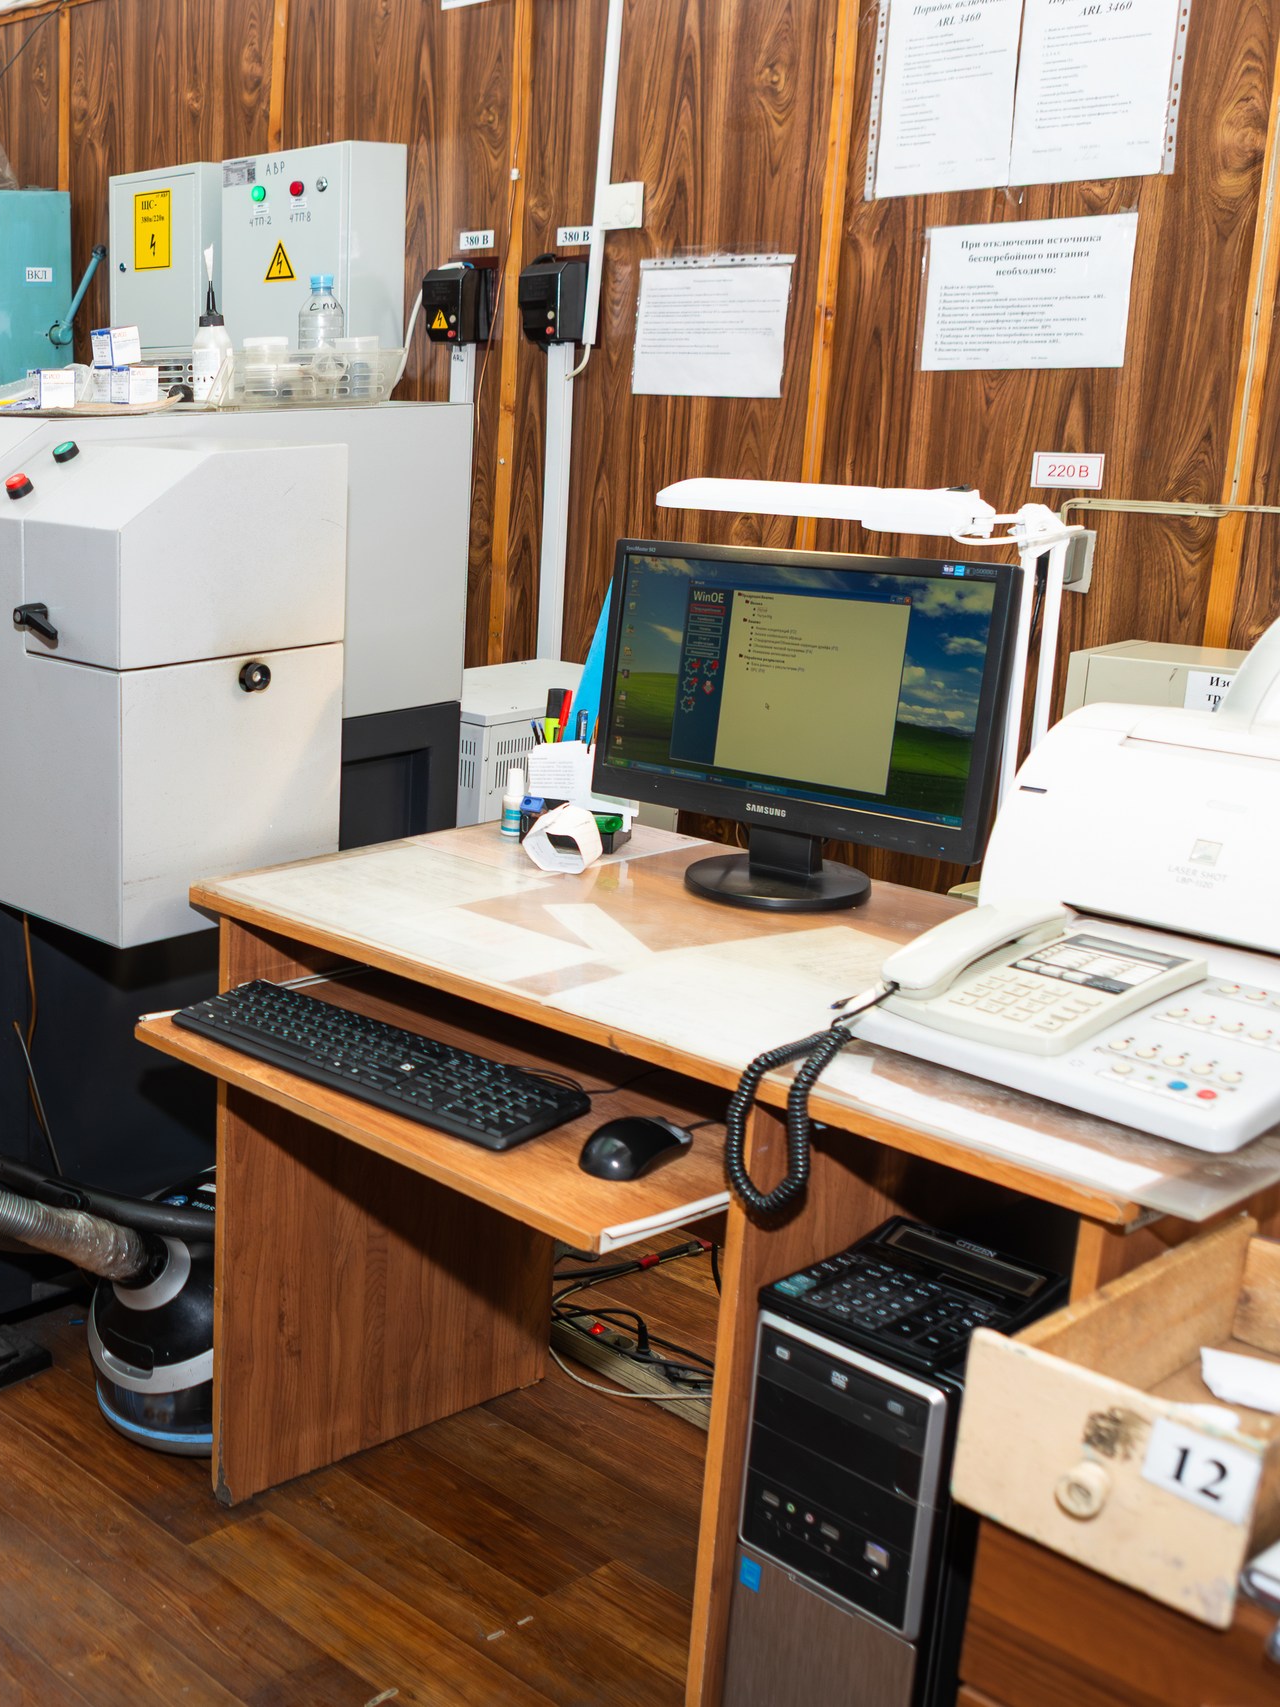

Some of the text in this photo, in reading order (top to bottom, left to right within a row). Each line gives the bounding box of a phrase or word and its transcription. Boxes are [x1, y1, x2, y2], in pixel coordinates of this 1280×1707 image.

[1078, 1, 1133, 17] ARL 3460
[935, 12, 982, 28] ARL 3460
[464, 234, 489, 246] 380 В
[562, 231, 590, 242] 380 В
[961, 235, 1102, 251] При отключении источника
[968, 250, 1090, 264] бесперебойного питания
[27, 269, 47, 280] ВКЛ
[995, 267, 1057, 277] необходимо:
[1047, 464, 1090, 478] 220 В
[694, 591, 725, 604] WinOE
[1206, 694, 1224, 705] тр
[745, 803, 787, 818] SAMSUNG
[956, 1240, 997, 1258] CITIZEN
[1173, 1446, 1227, 1500] 12
